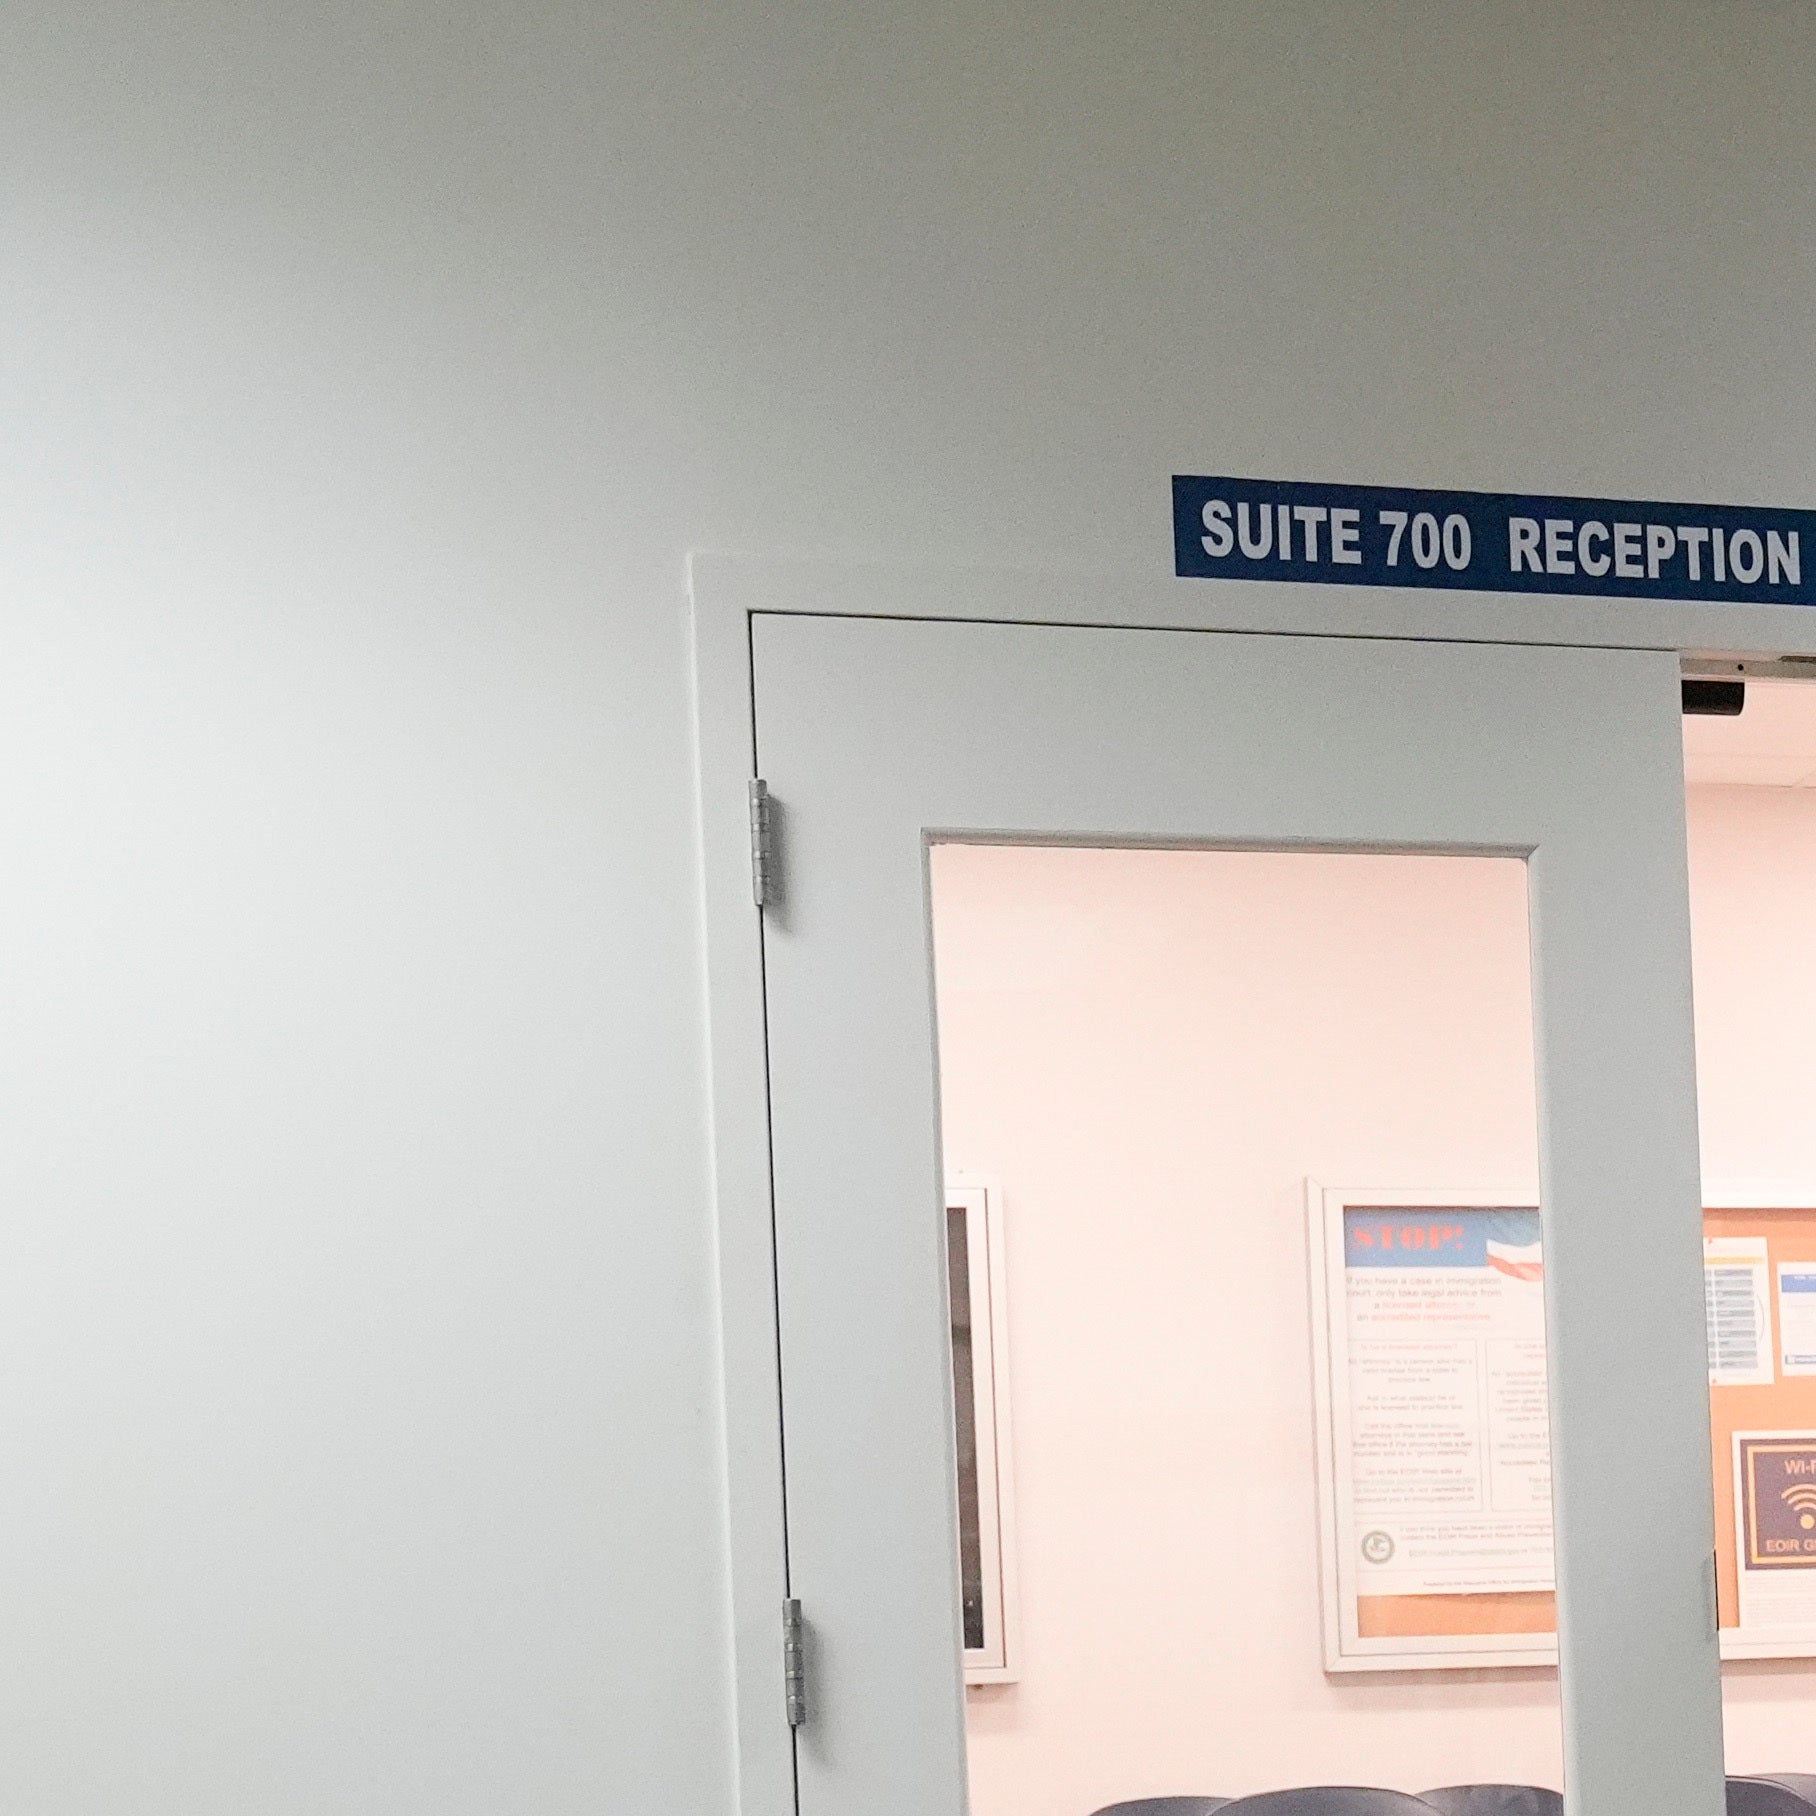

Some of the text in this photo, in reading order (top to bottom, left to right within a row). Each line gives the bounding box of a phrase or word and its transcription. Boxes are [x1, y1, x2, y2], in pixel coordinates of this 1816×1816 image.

[1201, 499, 1363, 564] SUITE
[1379, 510, 1471, 570] 700
[1509, 517, 1801, 585] RECEPTION
[1352, 1224, 1464, 1251] STOP!
